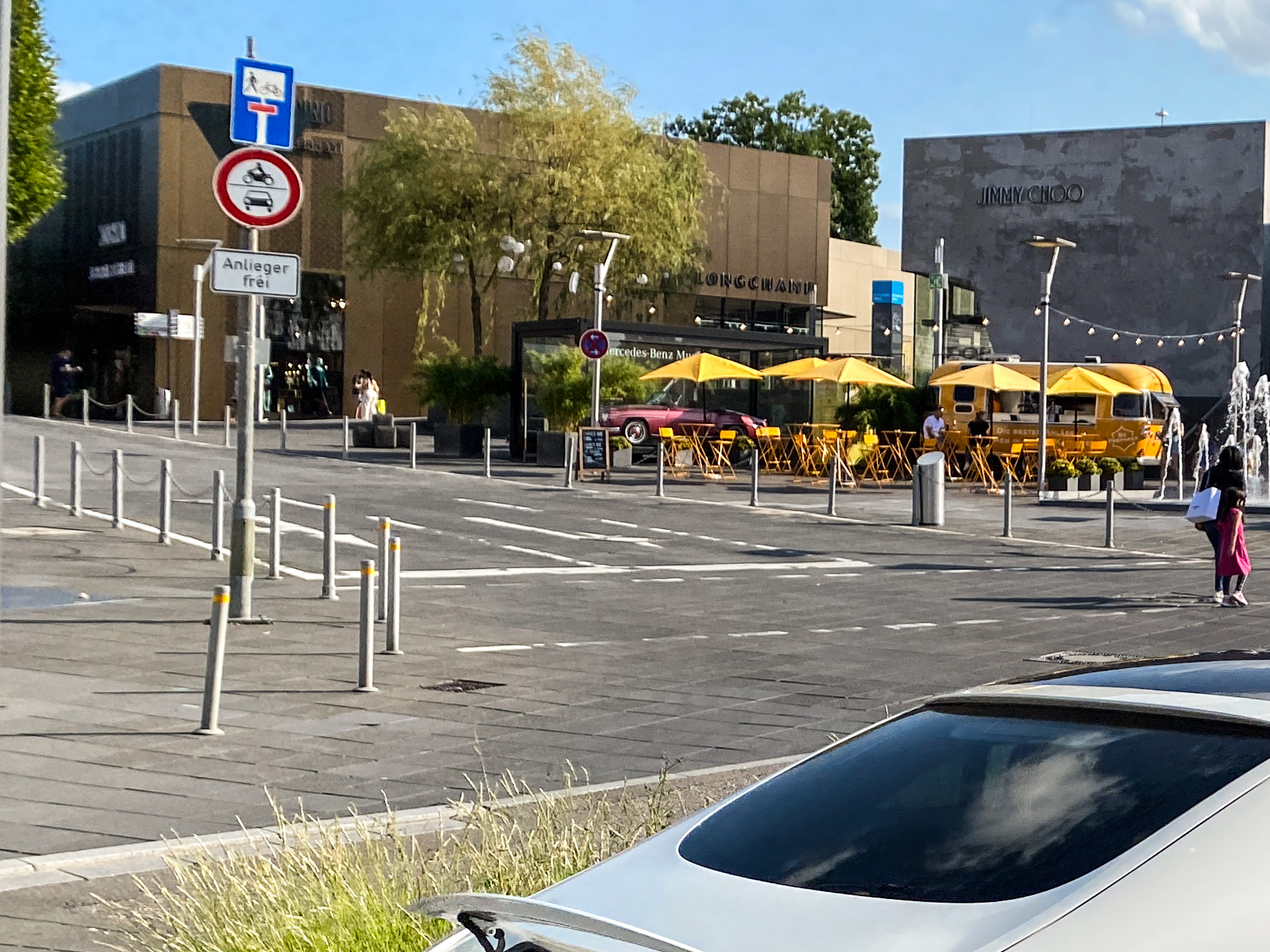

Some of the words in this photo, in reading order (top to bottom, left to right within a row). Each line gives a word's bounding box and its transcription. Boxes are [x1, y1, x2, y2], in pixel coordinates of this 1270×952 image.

[977, 186, 1024, 206] JIMMY
[1028, 183, 1085, 204] CHOO
[222, 257, 290, 276] Anlieger
[243, 273, 270, 289] frei
